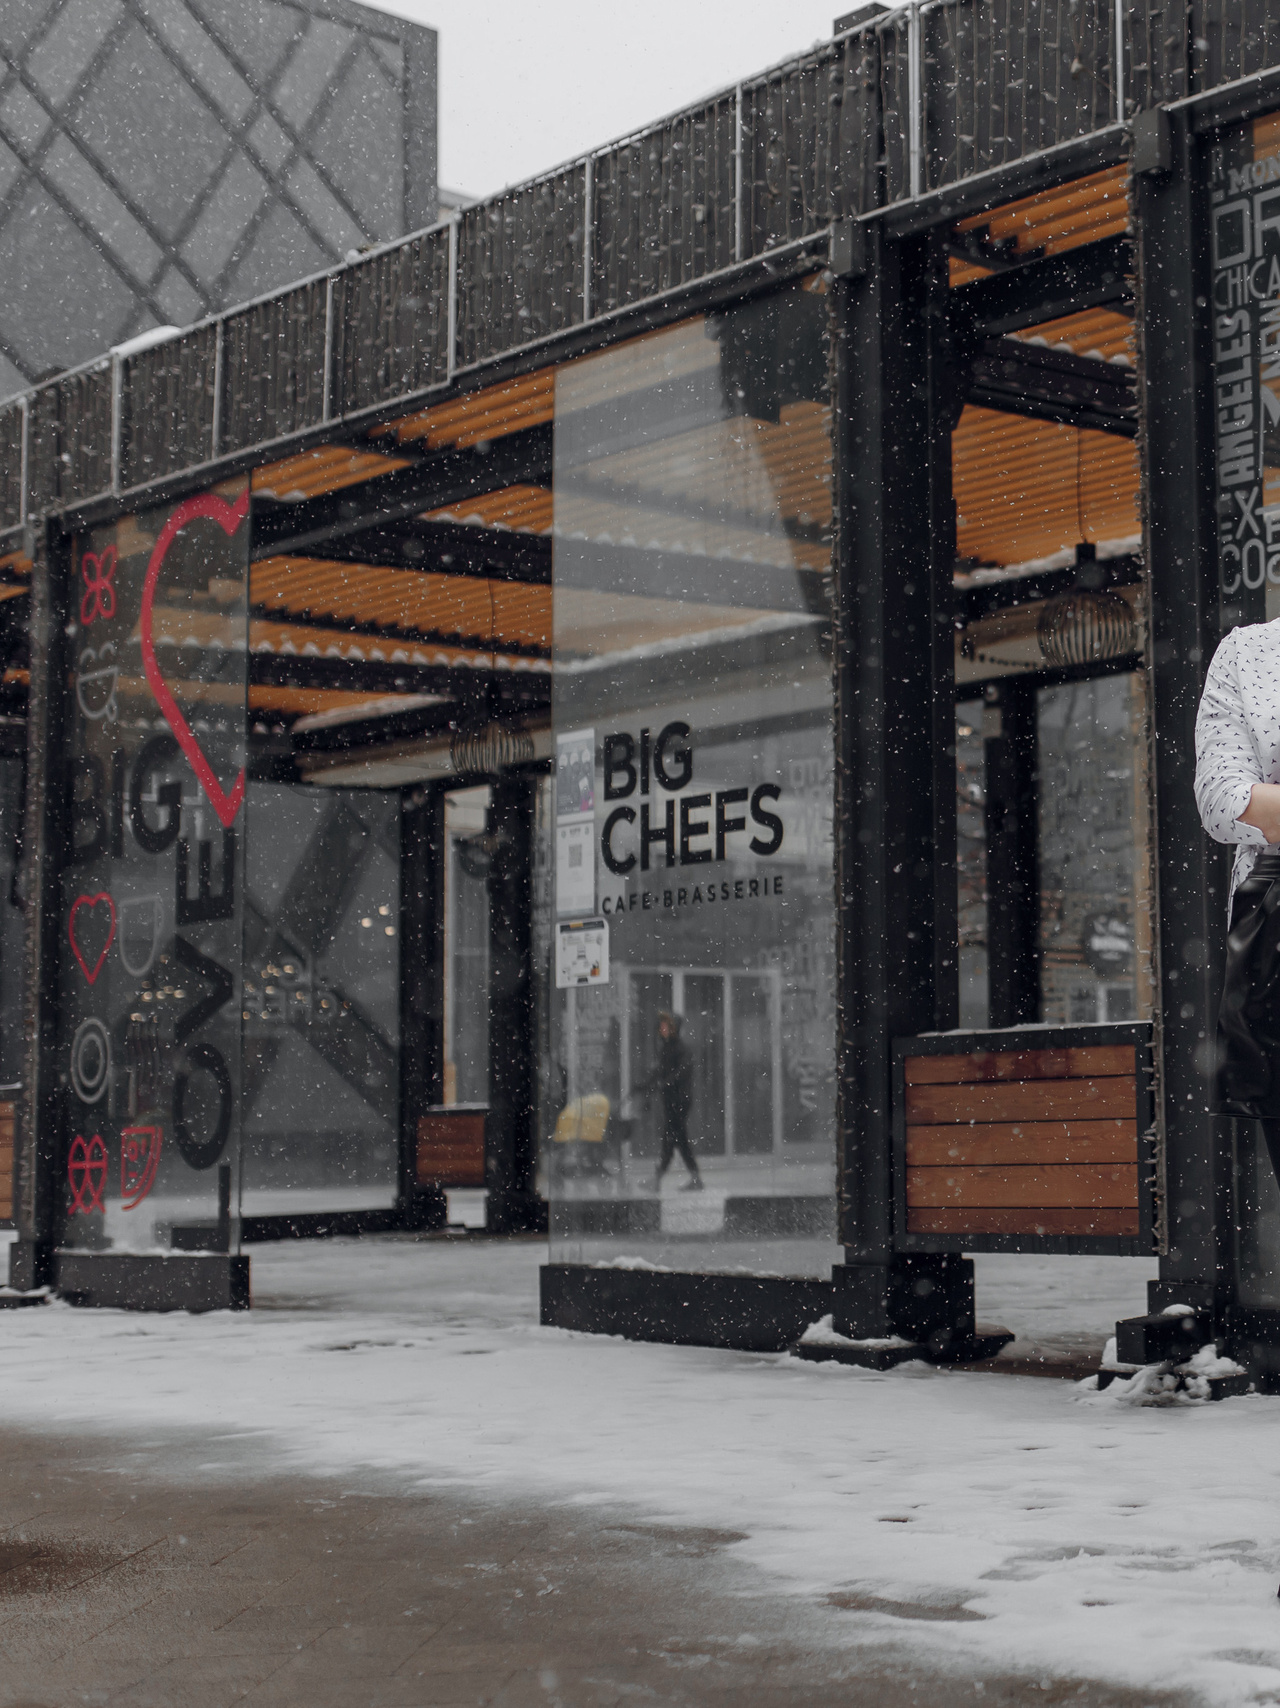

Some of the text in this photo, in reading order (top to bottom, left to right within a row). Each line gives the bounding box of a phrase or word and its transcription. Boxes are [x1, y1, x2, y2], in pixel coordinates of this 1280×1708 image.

[1214, 304, 1255, 488] ANGELES
[69, 734, 182, 856] BIG
[604, 720, 693, 802] BIG
[601, 783, 784, 876] CHEFS
[171, 827, 236, 1250] LOVE
